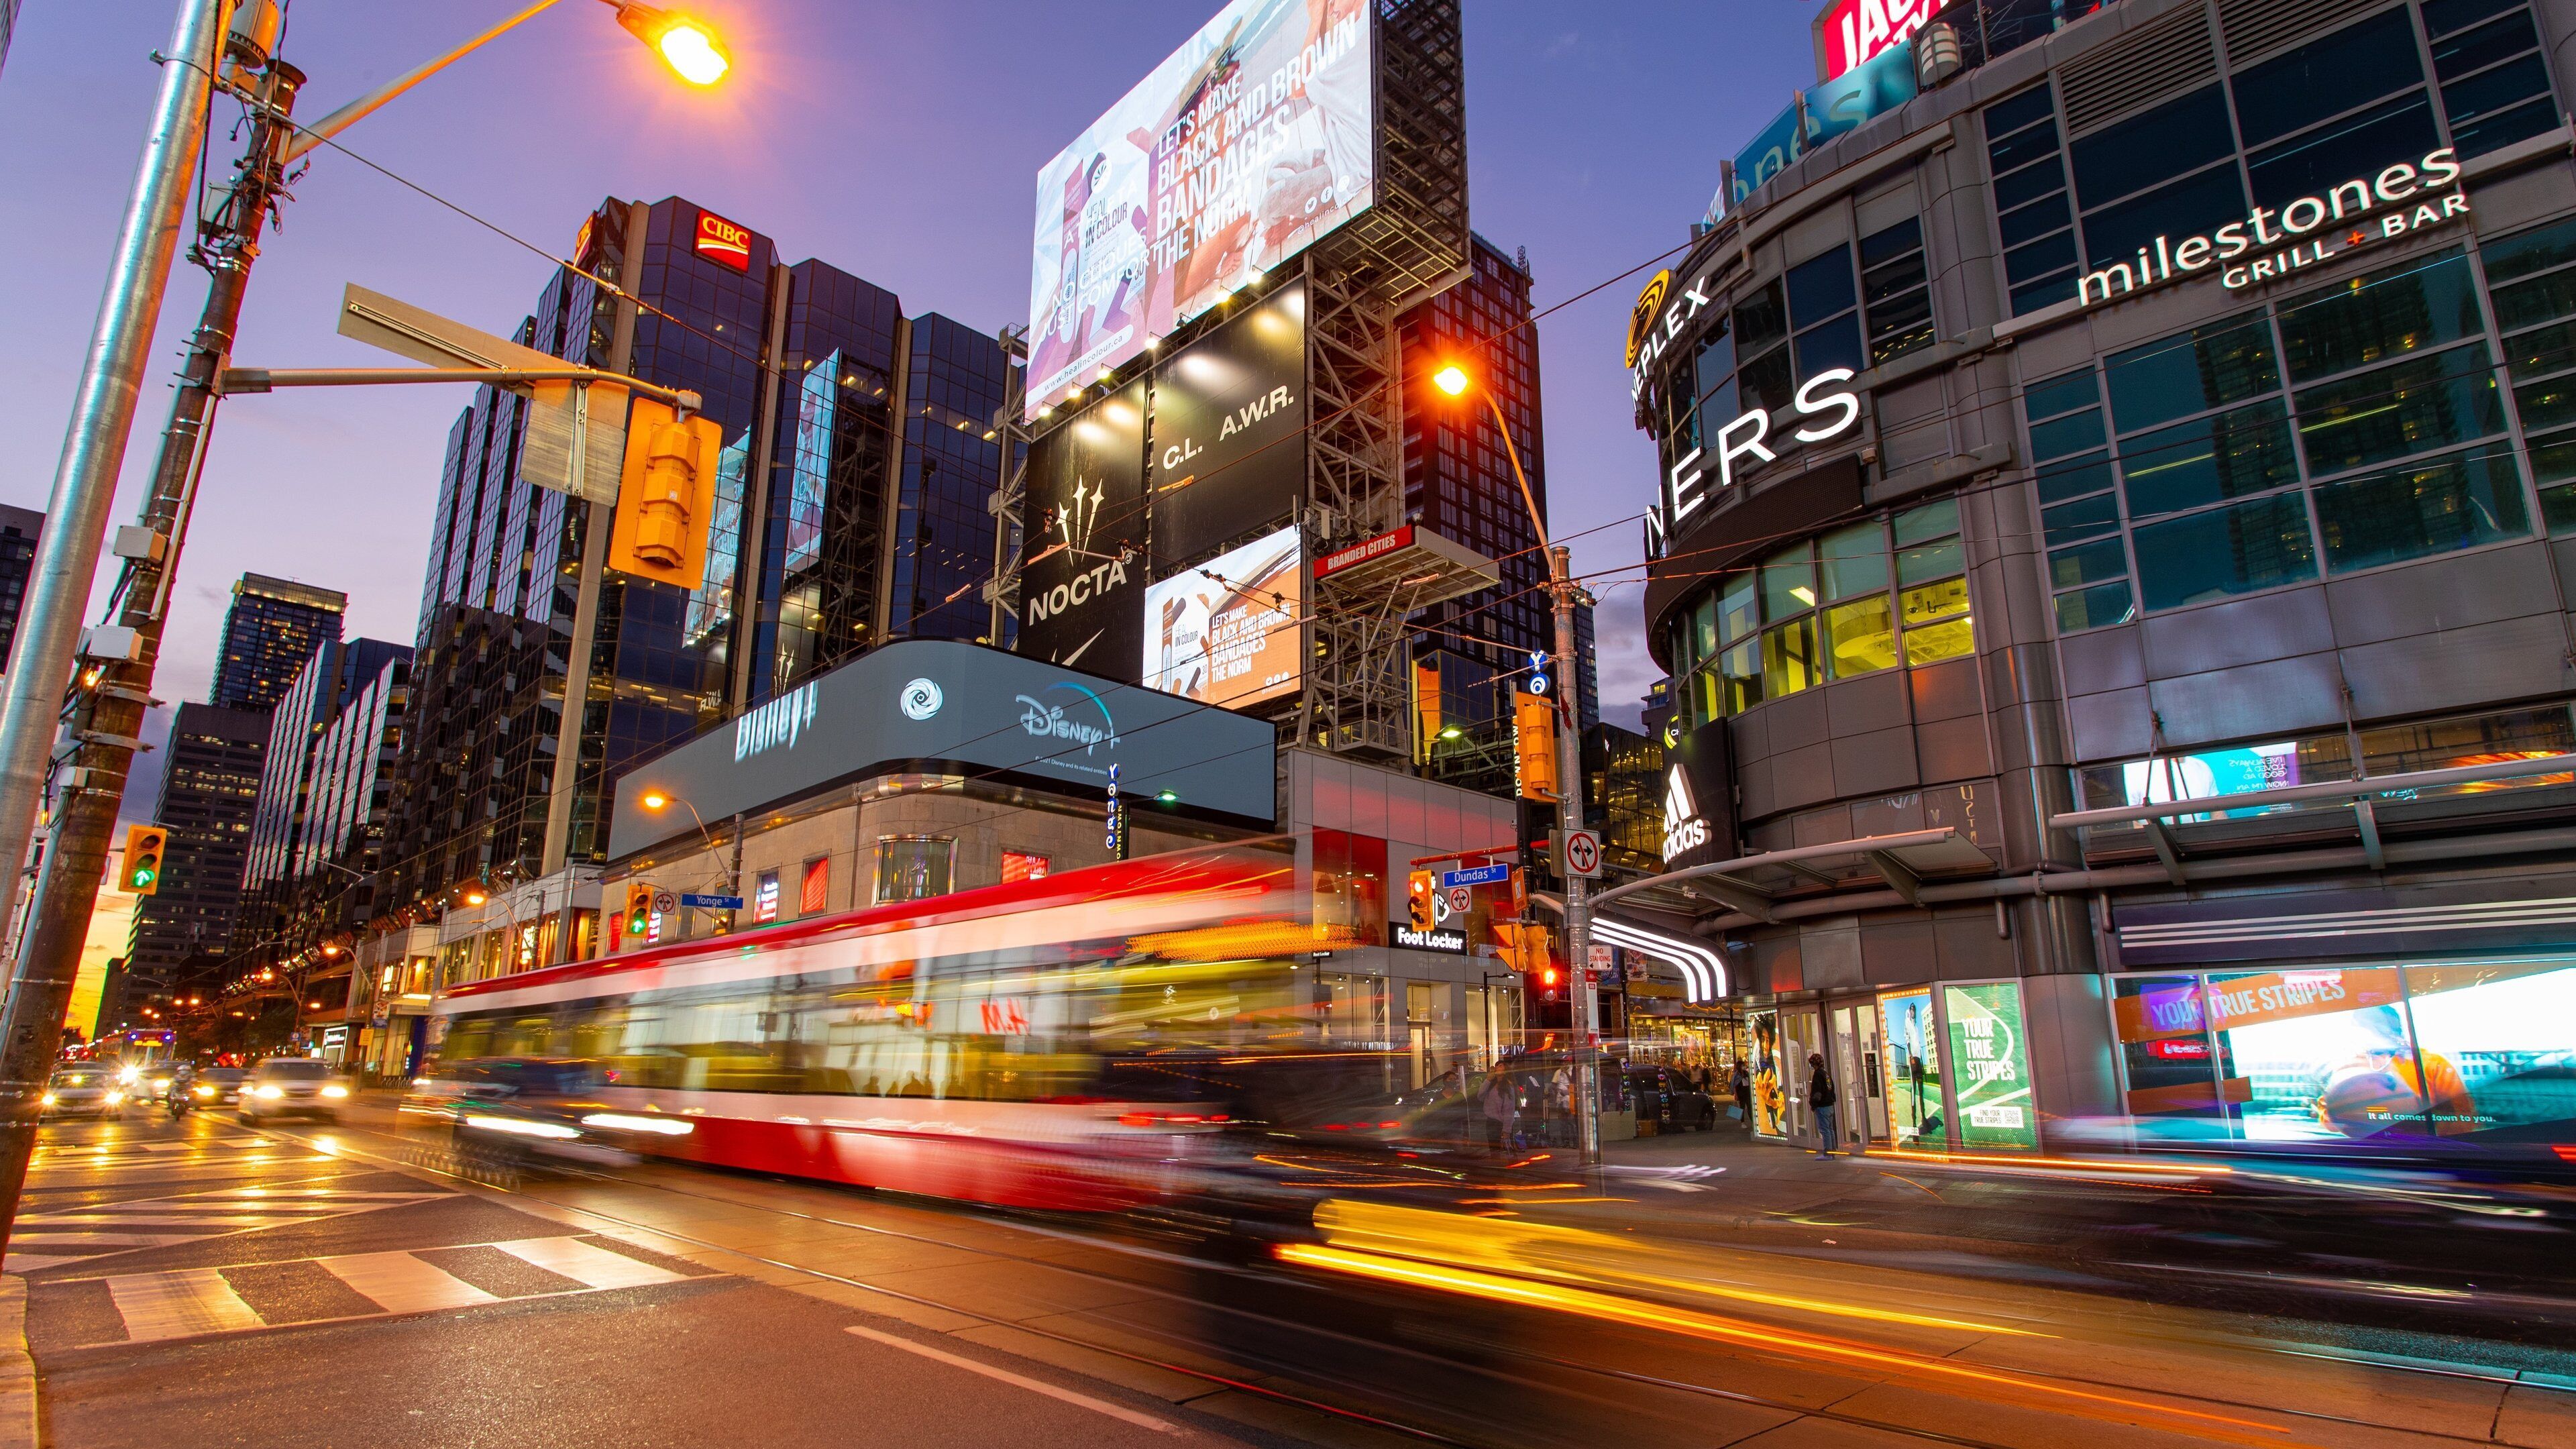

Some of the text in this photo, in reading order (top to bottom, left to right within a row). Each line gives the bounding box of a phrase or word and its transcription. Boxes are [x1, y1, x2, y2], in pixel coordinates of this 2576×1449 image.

[1158, 11, 1356, 196] BLACK AND BROWN
[1159, 70, 1241, 160] LET'S MAKE
[1157, 104, 1290, 240] BANDAGES
[702, 217, 748, 248] CIBC
[1097, 202, 1128, 239] COLOUR
[1155, 221, 1190, 275] THE
[1194, 178, 1252, 250] NORM
[2078, 148, 2461, 307] milestones
[2222, 239, 2335, 288] GRILL
[2381, 194, 2470, 238] BAR
[1044, 335, 1123, 392] www.healincolour.ca
[1163, 385, 1294, 470] C.L. A.W.R.
[1646, 368, 1859, 557] NERS
[1328, 534, 1395, 570] BRANDED CITIES
[1029, 560, 1127, 627] NOCTA
[1212, 604, 1247, 628] LET'S MAKE
[1212, 621, 1238, 645] BLACK
[1239, 615, 1257, 637] AND
[1175, 631, 1198, 647] IN COLOUR
[1212, 629, 1266, 666] BANDAGES
[1212, 655, 1251, 683] THE NORM
[1051, 759, 1065, 768] Disney
[1079, 763, 1093, 772] related
[1663, 818, 1705, 864] adidas
[1454, 869, 1488, 883] Dundas
[696, 896, 722, 907] Yonge
[1397, 927, 1462, 949] Foot Locker
[2151, 977, 2346, 1026] YOUR TRUE STRIPES
[1962, 1018, 1994, 1038] YOUR
[1964, 1039, 1994, 1059] TRUE
[1966, 1061, 2016, 1081] STRIPES
[2377, 1112, 2392, 1120] all
[2473, 1115, 2496, 1124] you.
